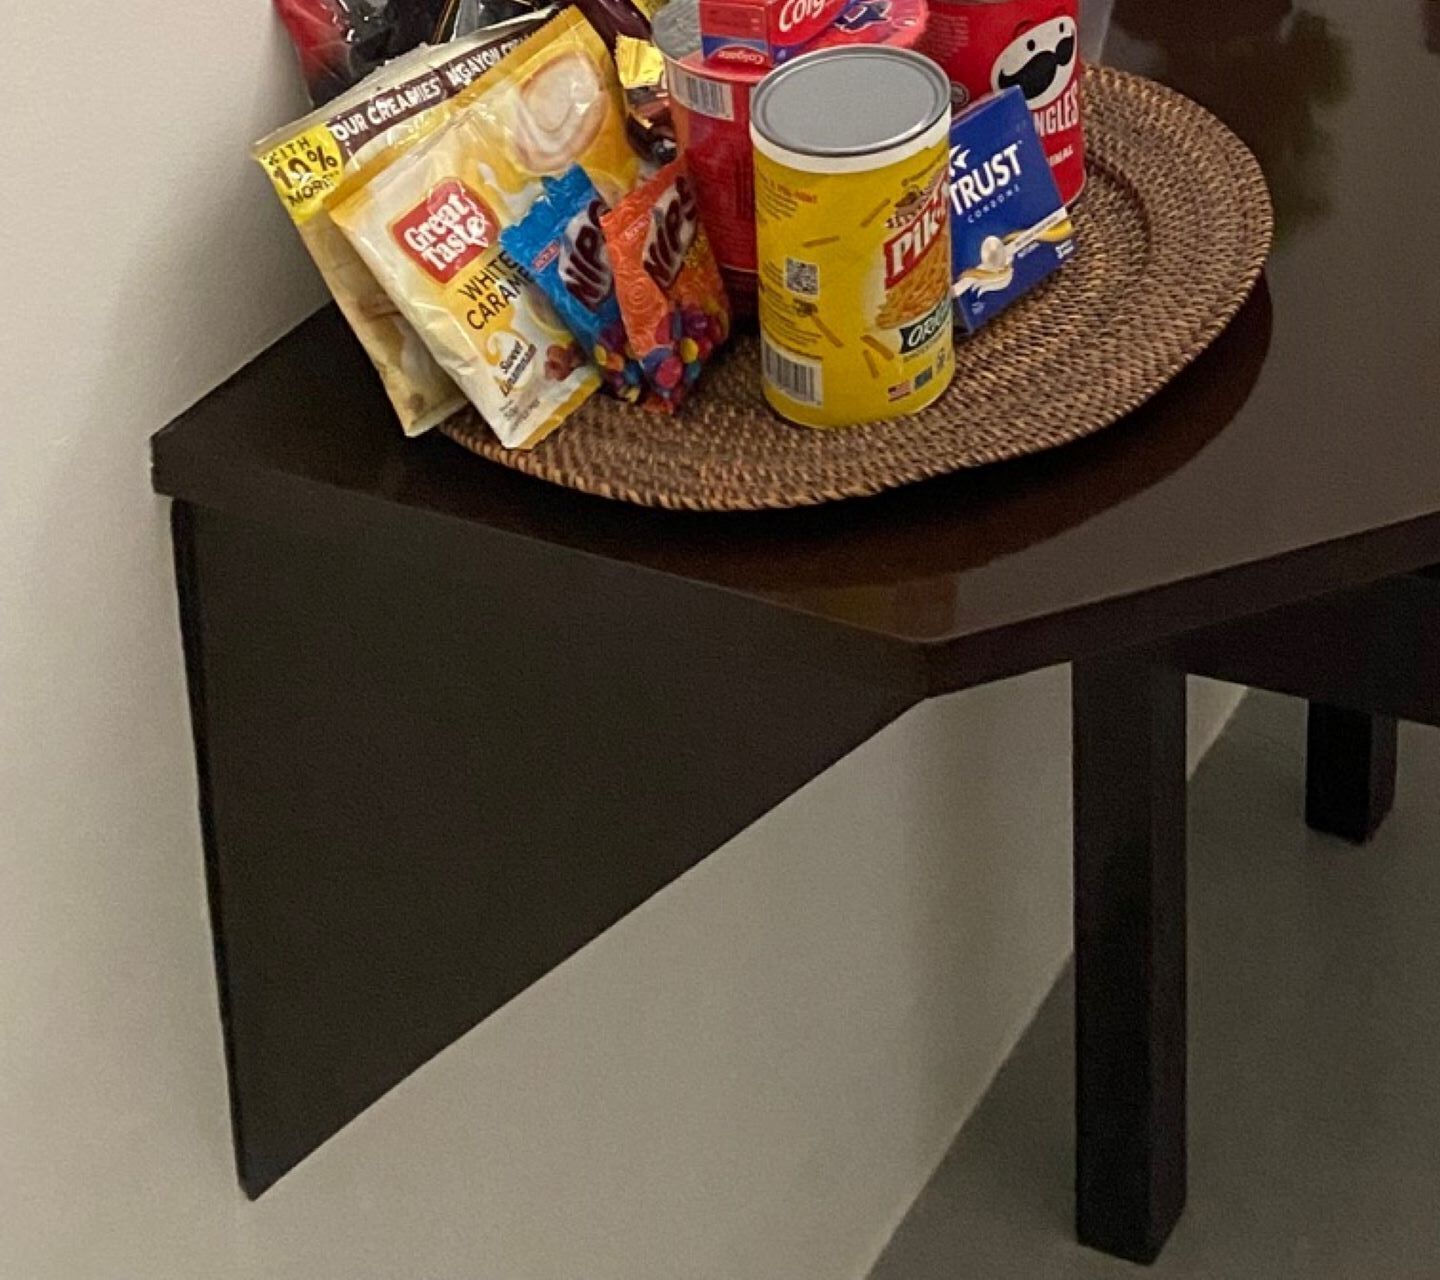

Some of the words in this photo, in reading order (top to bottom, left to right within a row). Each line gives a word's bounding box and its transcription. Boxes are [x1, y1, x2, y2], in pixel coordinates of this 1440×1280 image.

[261, 135, 310, 166] WITH
[330, 111, 370, 141] OUR
[949, 142, 1022, 215] TRUST
[403, 192, 470, 252] Great
[421, 216, 489, 271] Taste
[458, 250, 519, 301] WHITE
